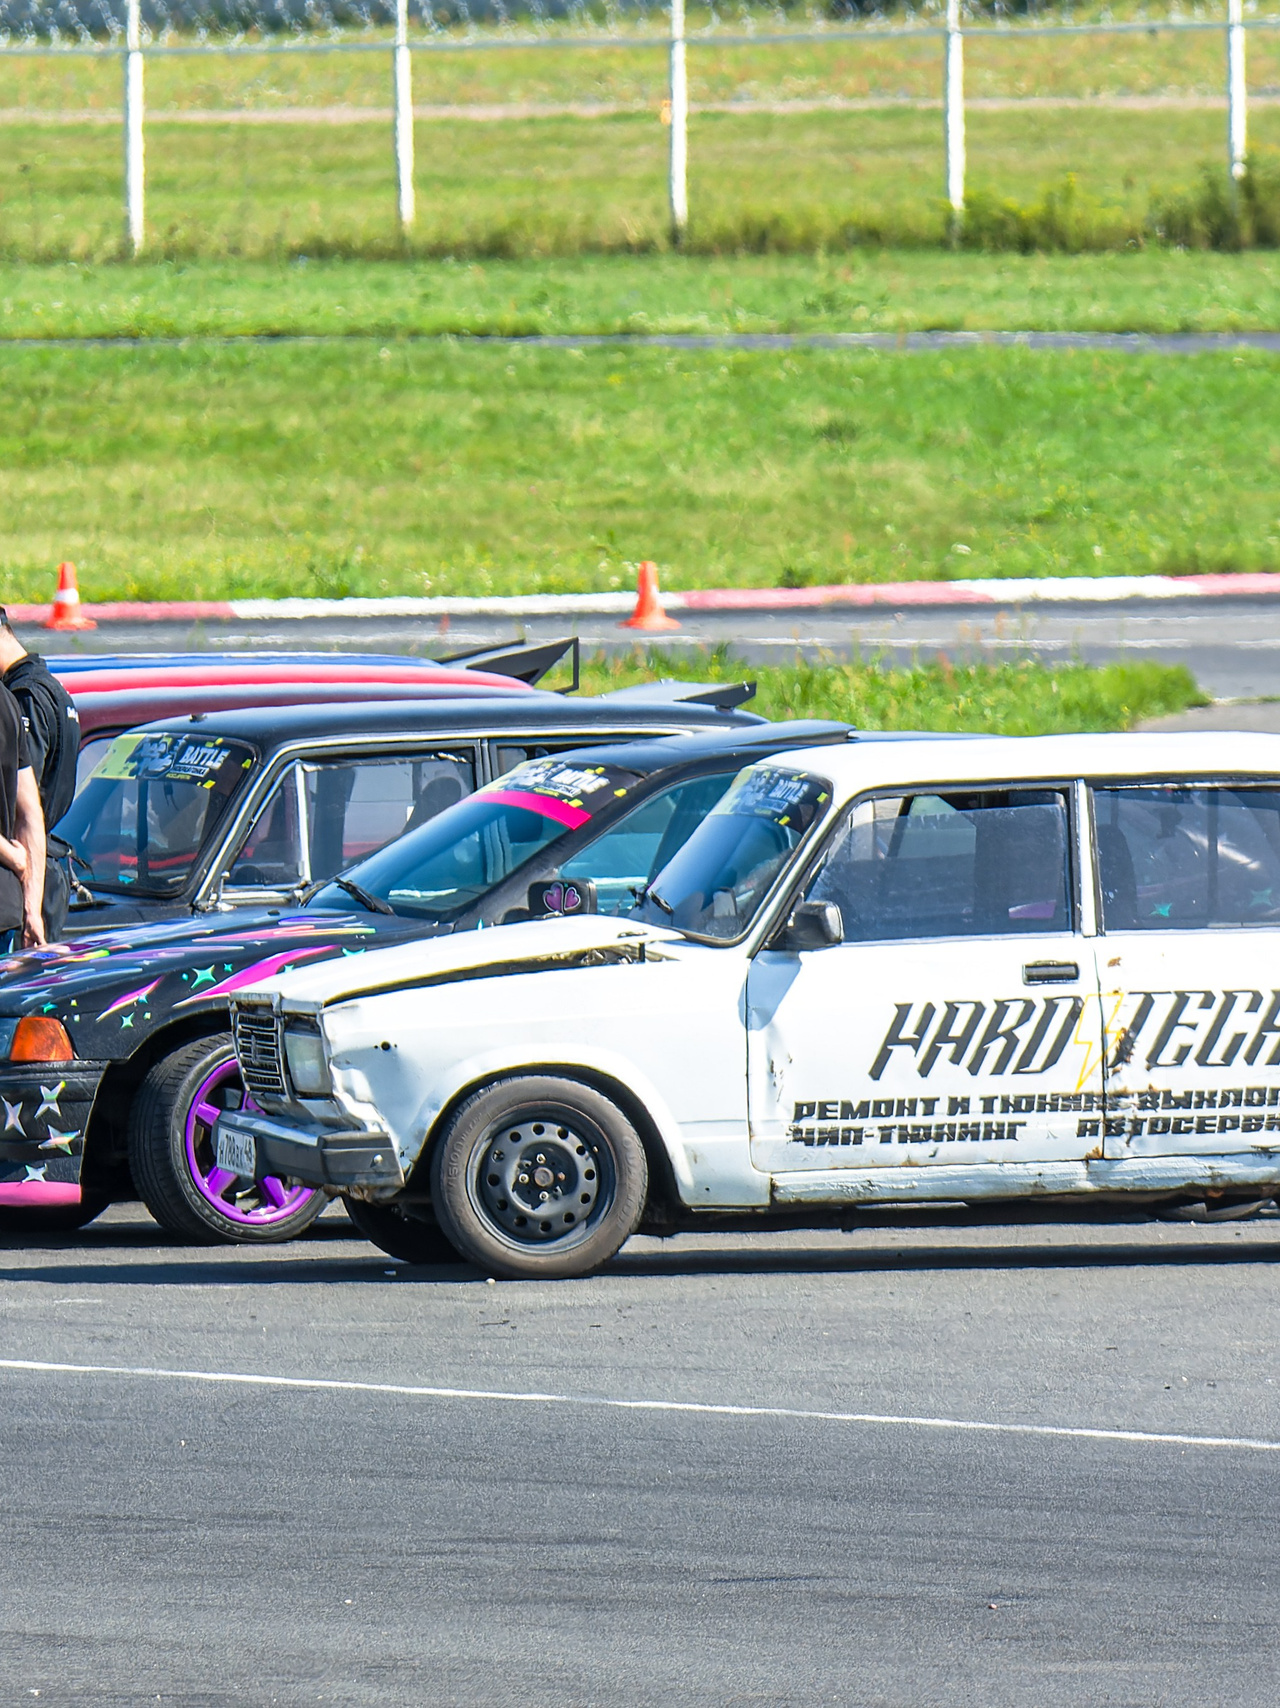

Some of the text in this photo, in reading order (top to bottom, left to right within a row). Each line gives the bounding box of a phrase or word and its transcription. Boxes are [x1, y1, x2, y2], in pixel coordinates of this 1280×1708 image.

[179, 745, 231, 770] BATTLE
[868, 995, 1085, 1081] HARD
[792, 1096, 940, 1123] РЕМОНТ
[946, 1095, 971, 1116] И
[790, 1121, 1027, 1146] ЧИП-ТЮНИНГ
